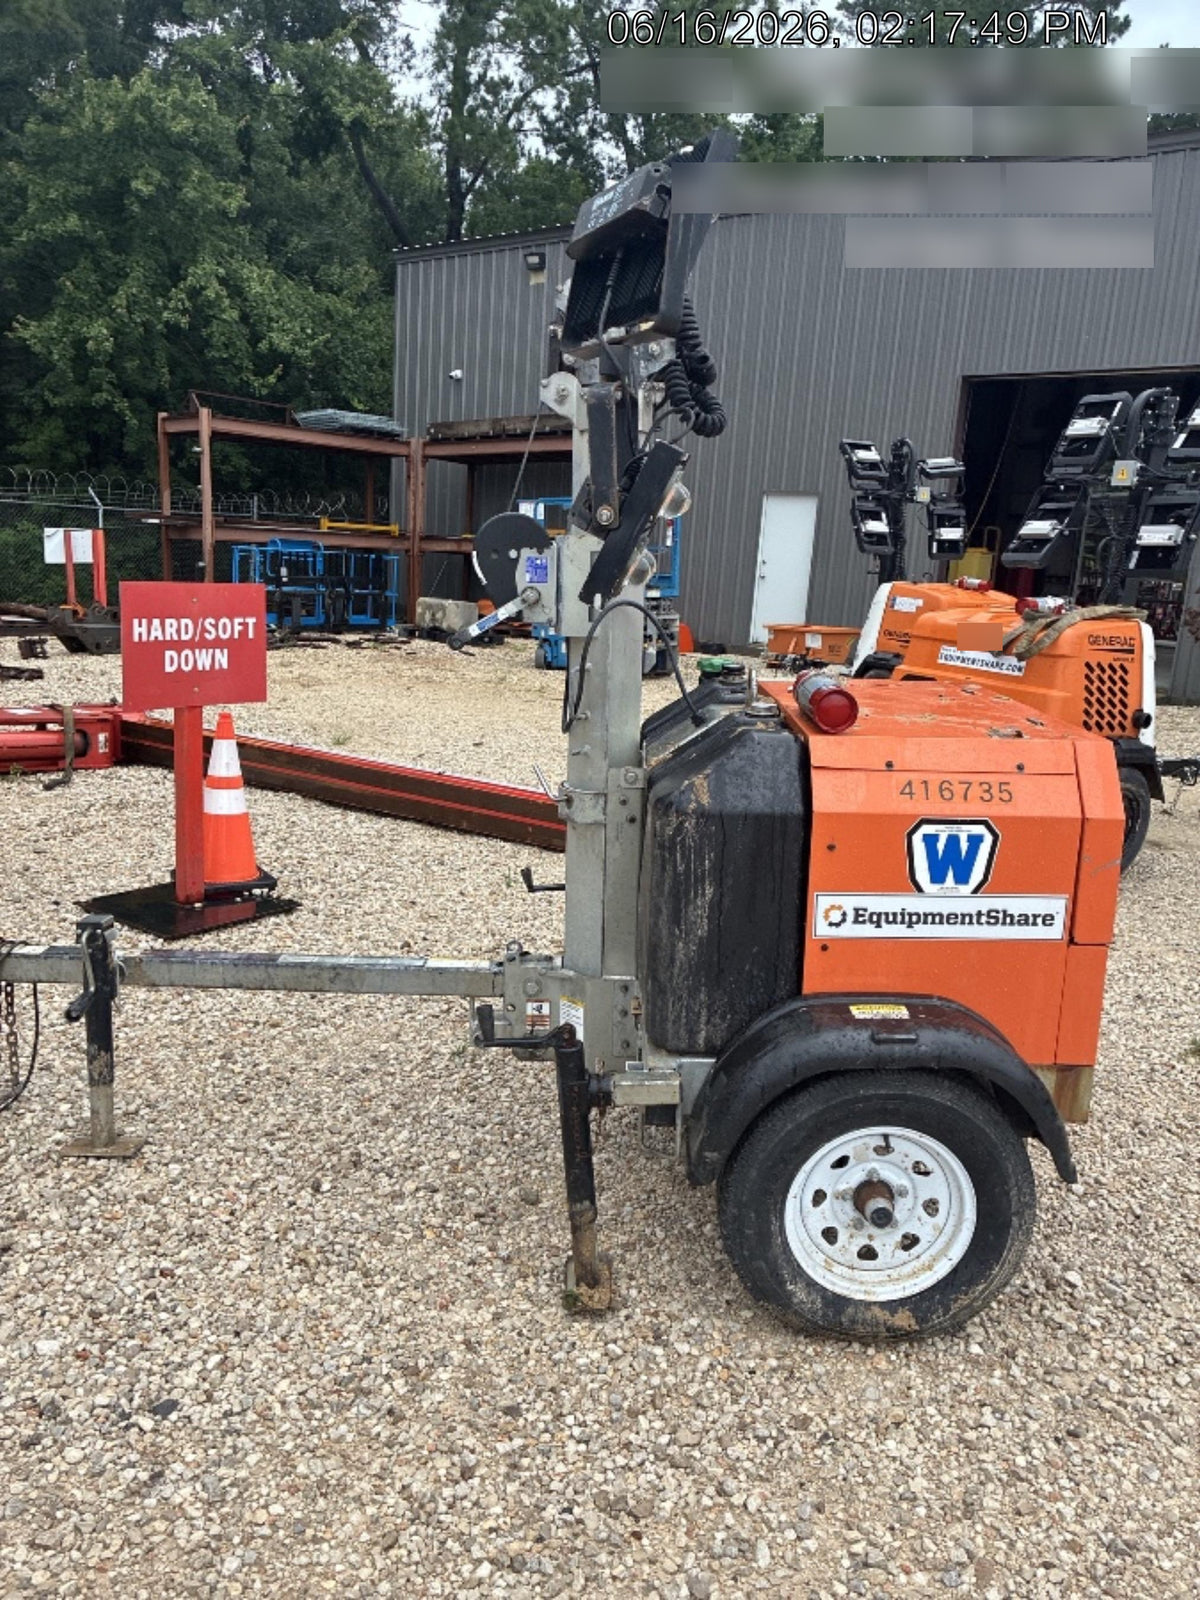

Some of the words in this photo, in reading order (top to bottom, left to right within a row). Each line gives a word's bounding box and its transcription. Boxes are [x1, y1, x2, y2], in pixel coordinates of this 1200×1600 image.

[132, 617, 257, 642] HARD/SOFT
[164, 648, 229, 673] DOWN
[899, 780, 1014, 803] 416735
[921, 833, 985, 885] W
[852, 906, 1056, 930] EquipmentShare
